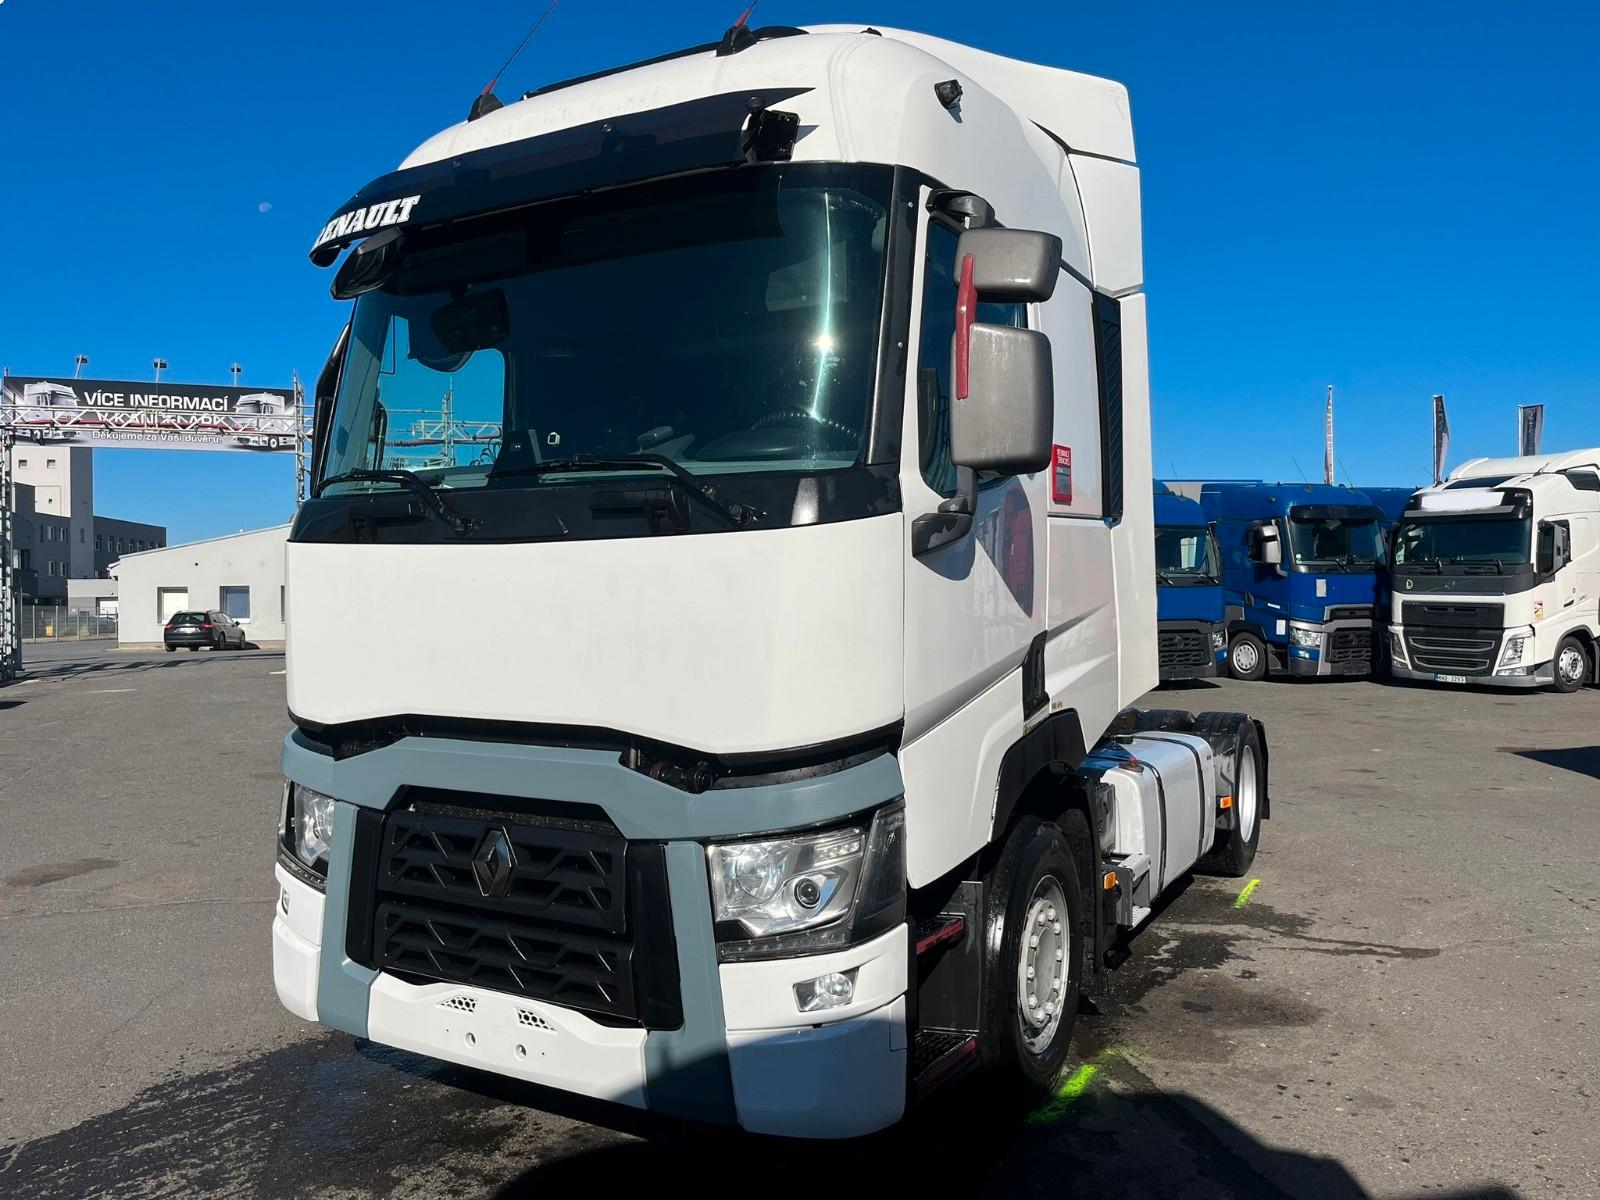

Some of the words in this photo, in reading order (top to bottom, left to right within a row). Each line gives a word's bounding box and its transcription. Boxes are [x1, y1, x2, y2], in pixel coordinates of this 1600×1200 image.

[315, 195, 421, 246] ENAULT
[84, 390, 125, 406] VÍCE
[129, 394, 229, 412] INFORMACÍ
[92, 431, 143, 441] Děkujeme
[145, 433, 158, 441] za
